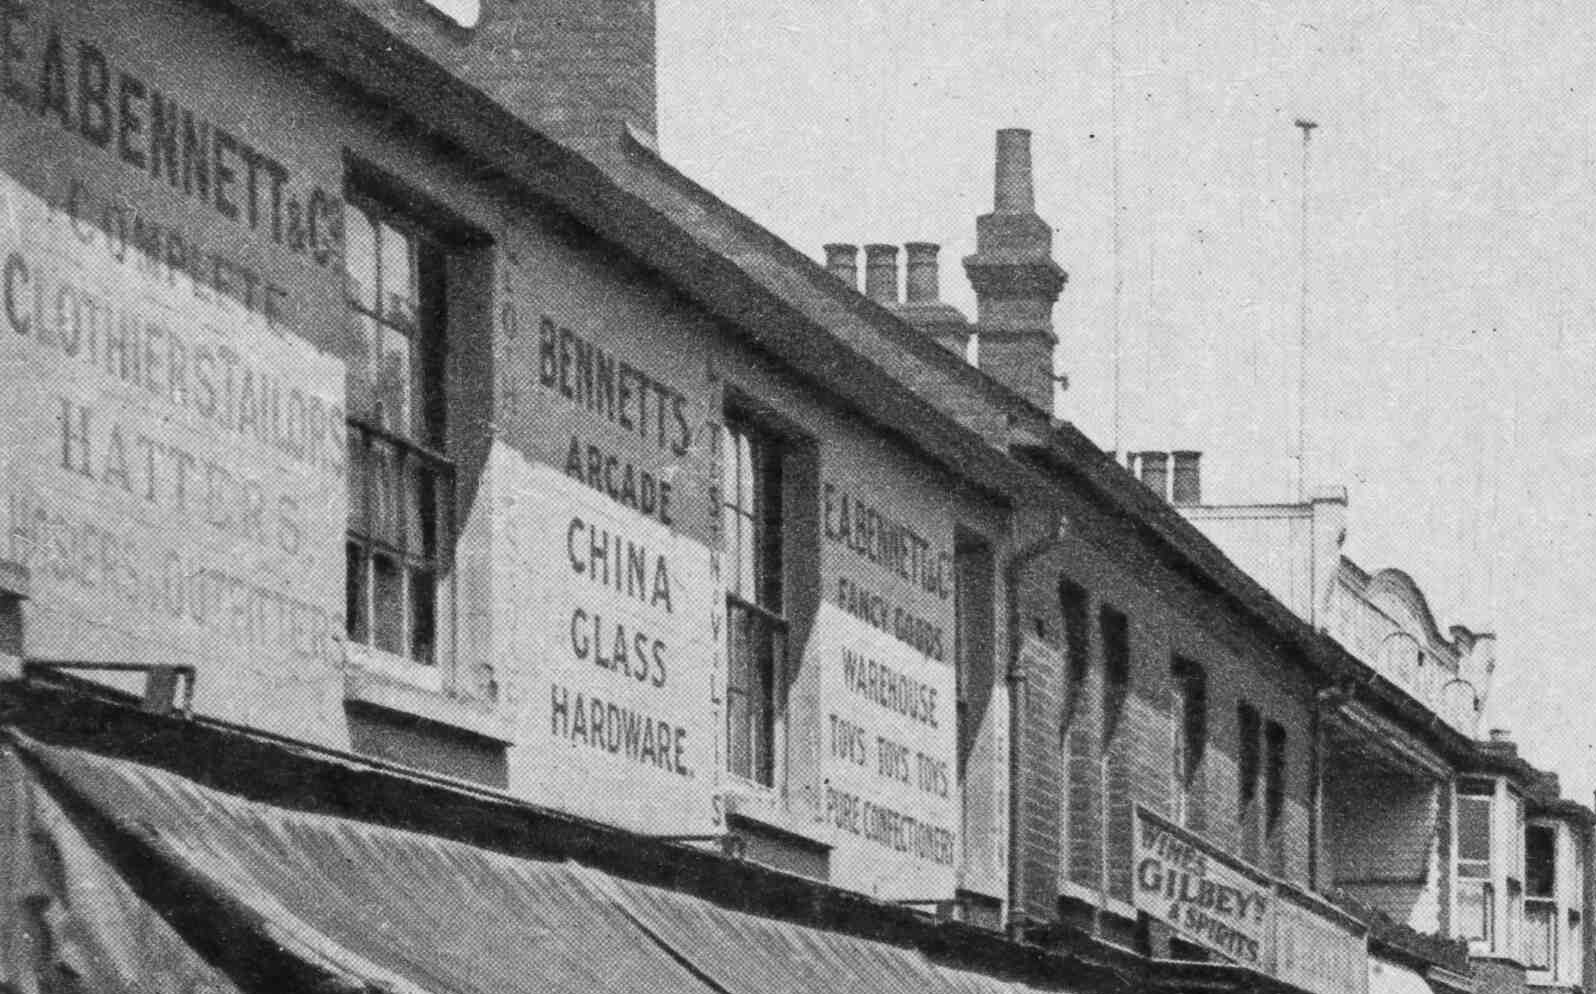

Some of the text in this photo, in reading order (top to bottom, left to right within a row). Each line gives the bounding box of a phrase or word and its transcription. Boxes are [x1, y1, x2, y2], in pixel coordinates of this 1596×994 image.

[565, 435, 674, 527] ARCADE
[566, 515, 674, 614] CHINA
[569, 607, 668, 690] GLASS
[841, 643, 940, 732] WAREHOUSE
[828, 711, 950, 800] TOYS TOYS TOYS
